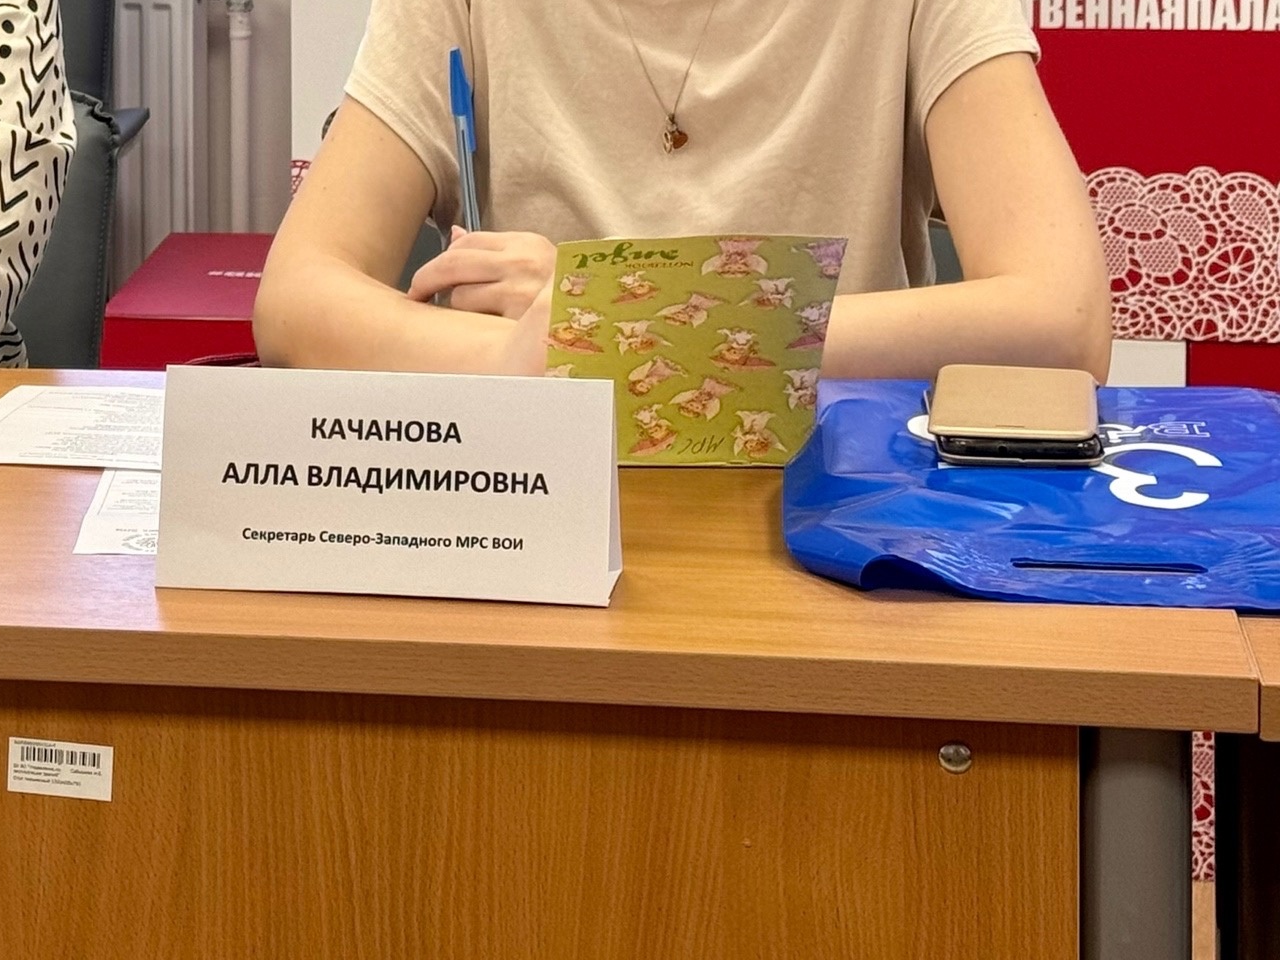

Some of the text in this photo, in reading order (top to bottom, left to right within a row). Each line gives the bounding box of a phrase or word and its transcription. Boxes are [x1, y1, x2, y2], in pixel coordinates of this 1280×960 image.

[311, 417, 462, 444] КАЧАНОВА
[221, 462, 549, 495] АЛЛА ВЛАДИМИРОВНА
[242, 527, 524, 551] Секретарь Северо-Западного МРС ВОИ
